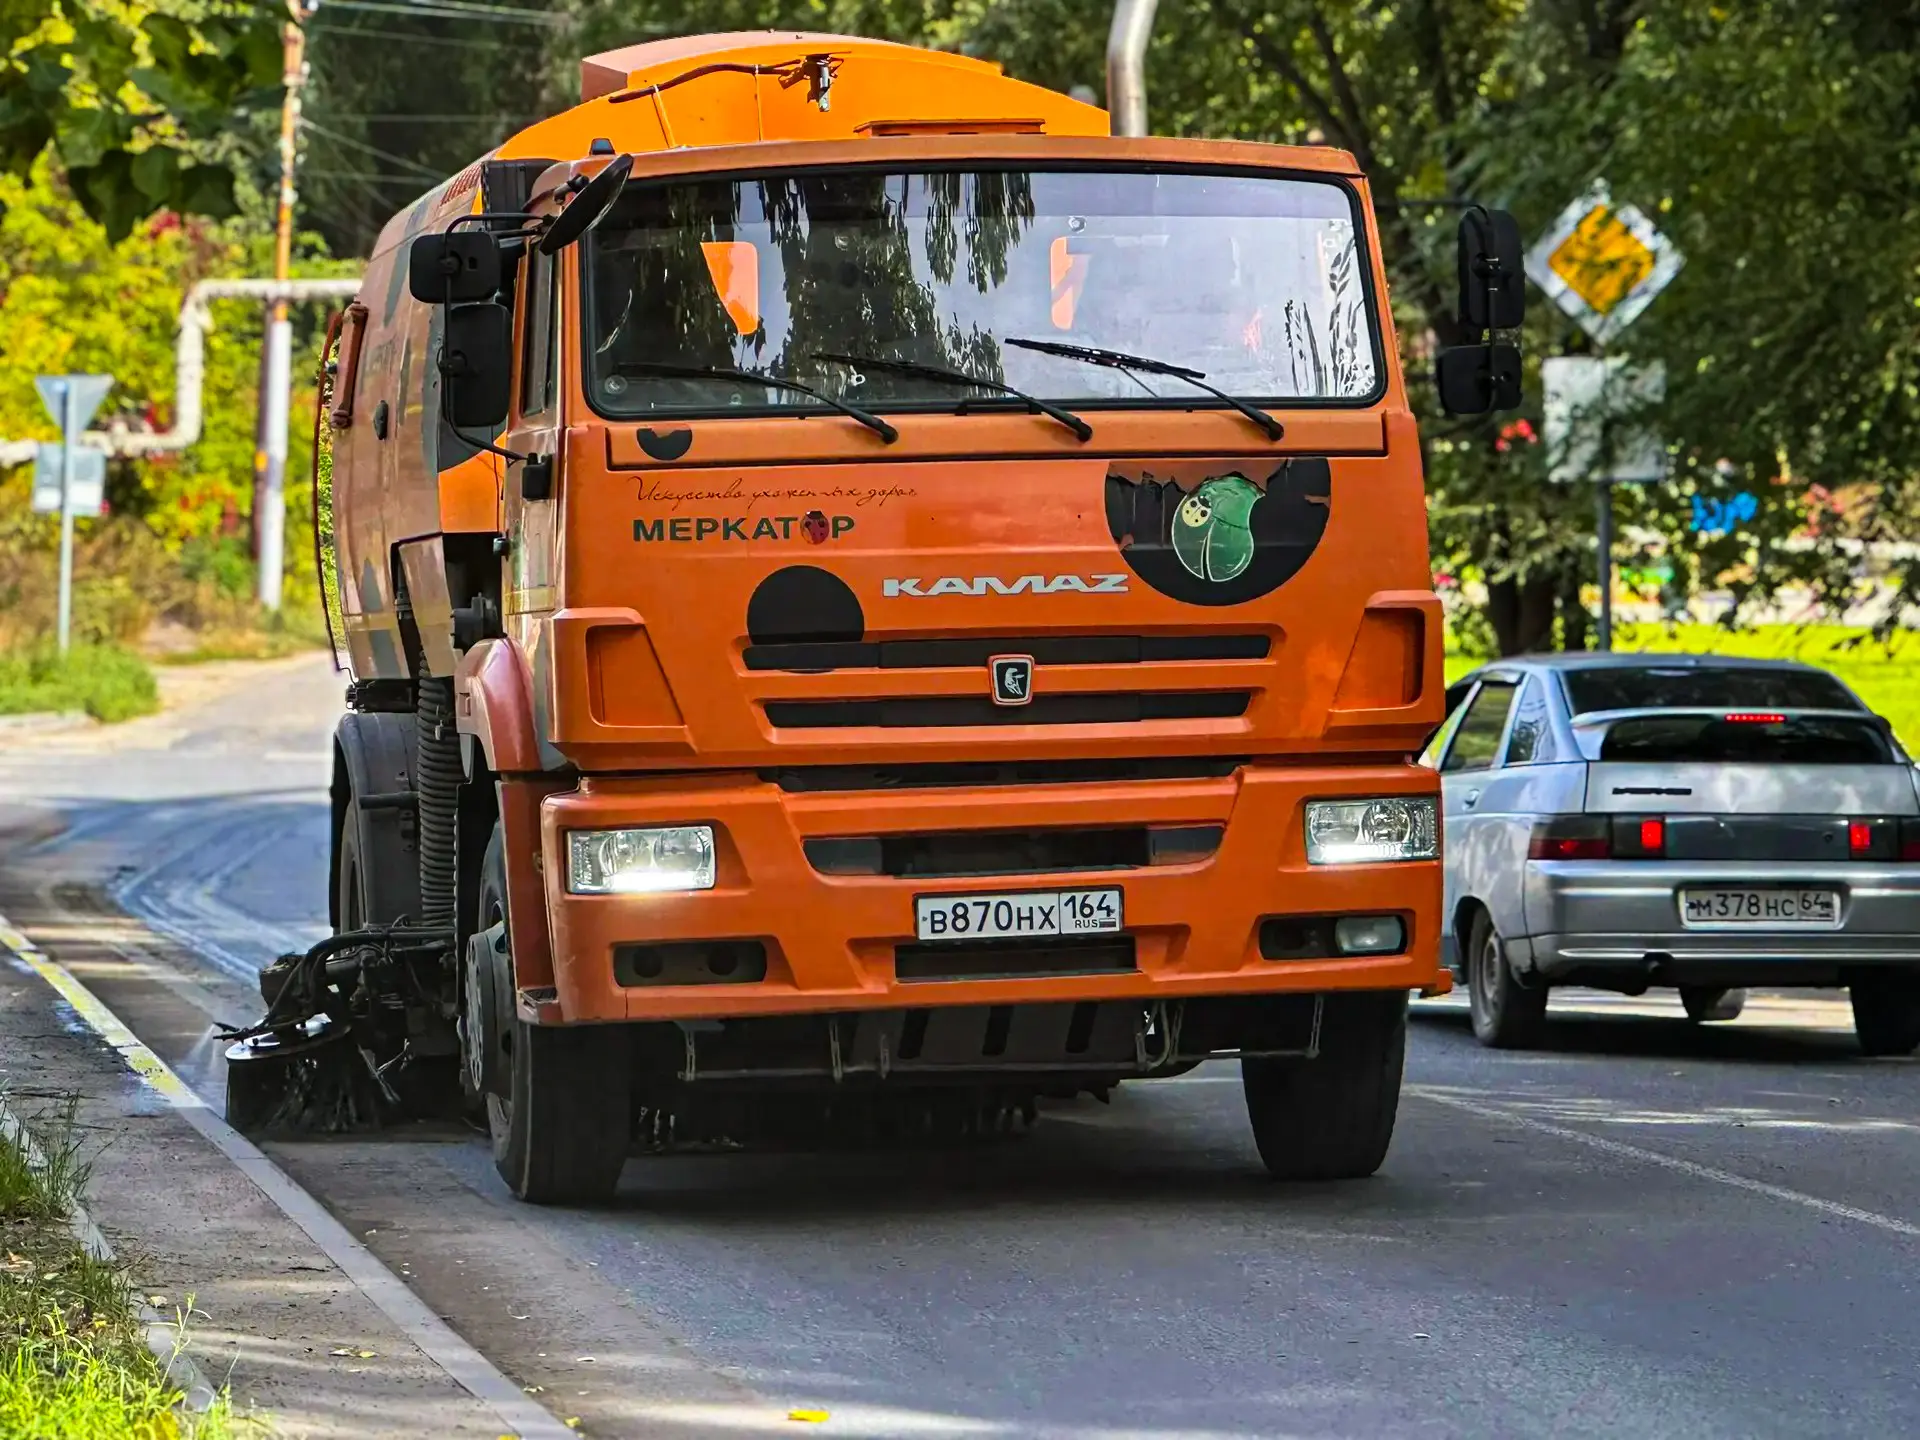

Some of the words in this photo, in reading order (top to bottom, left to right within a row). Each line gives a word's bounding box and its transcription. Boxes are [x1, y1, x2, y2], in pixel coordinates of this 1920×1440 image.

[632, 510, 855, 545] МЕРКАТОР
[882, 574, 1129, 597] KAMAZ
[930, 900, 1056, 934] В870НХ
[1064, 893, 1112, 919] 164
[1074, 919, 1098, 929] RUS
